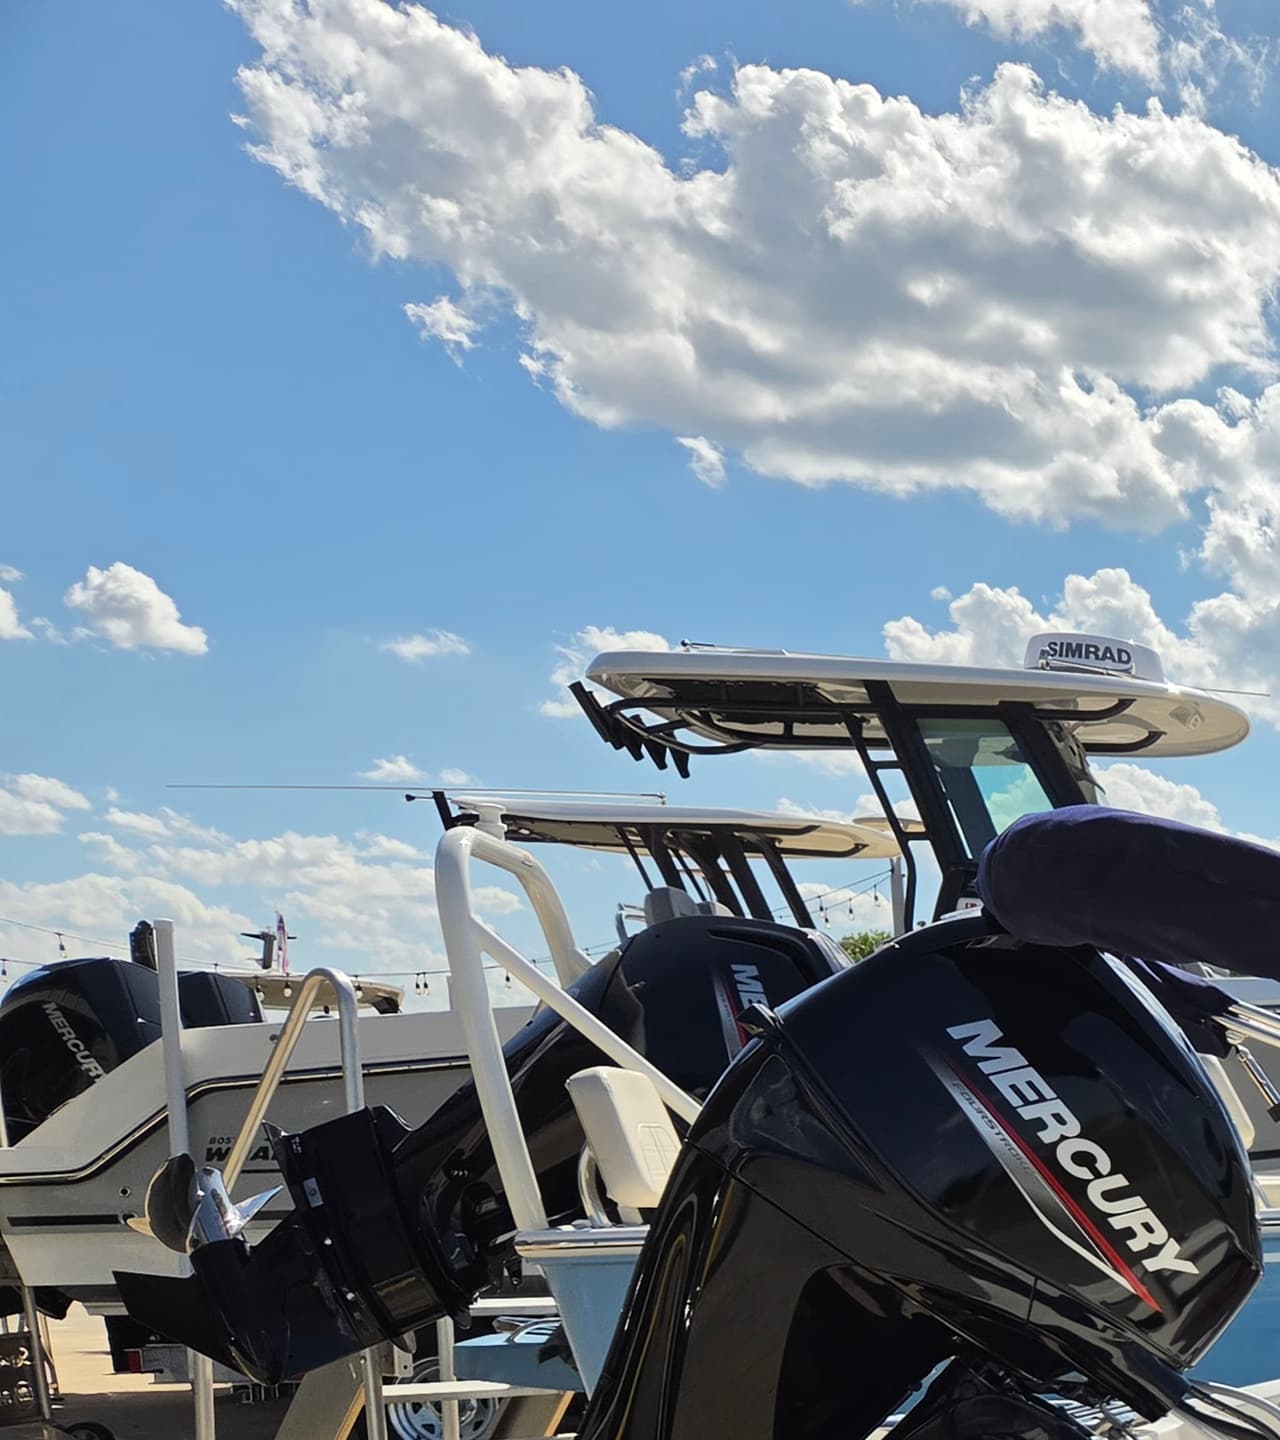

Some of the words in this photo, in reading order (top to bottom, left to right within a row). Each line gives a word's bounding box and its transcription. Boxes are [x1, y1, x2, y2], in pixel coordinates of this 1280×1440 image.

[1047, 641, 1132, 665] SIMRAD
[42, 1001, 107, 1083] MERCUR
[945, 1018, 1200, 1275] MERCURY
